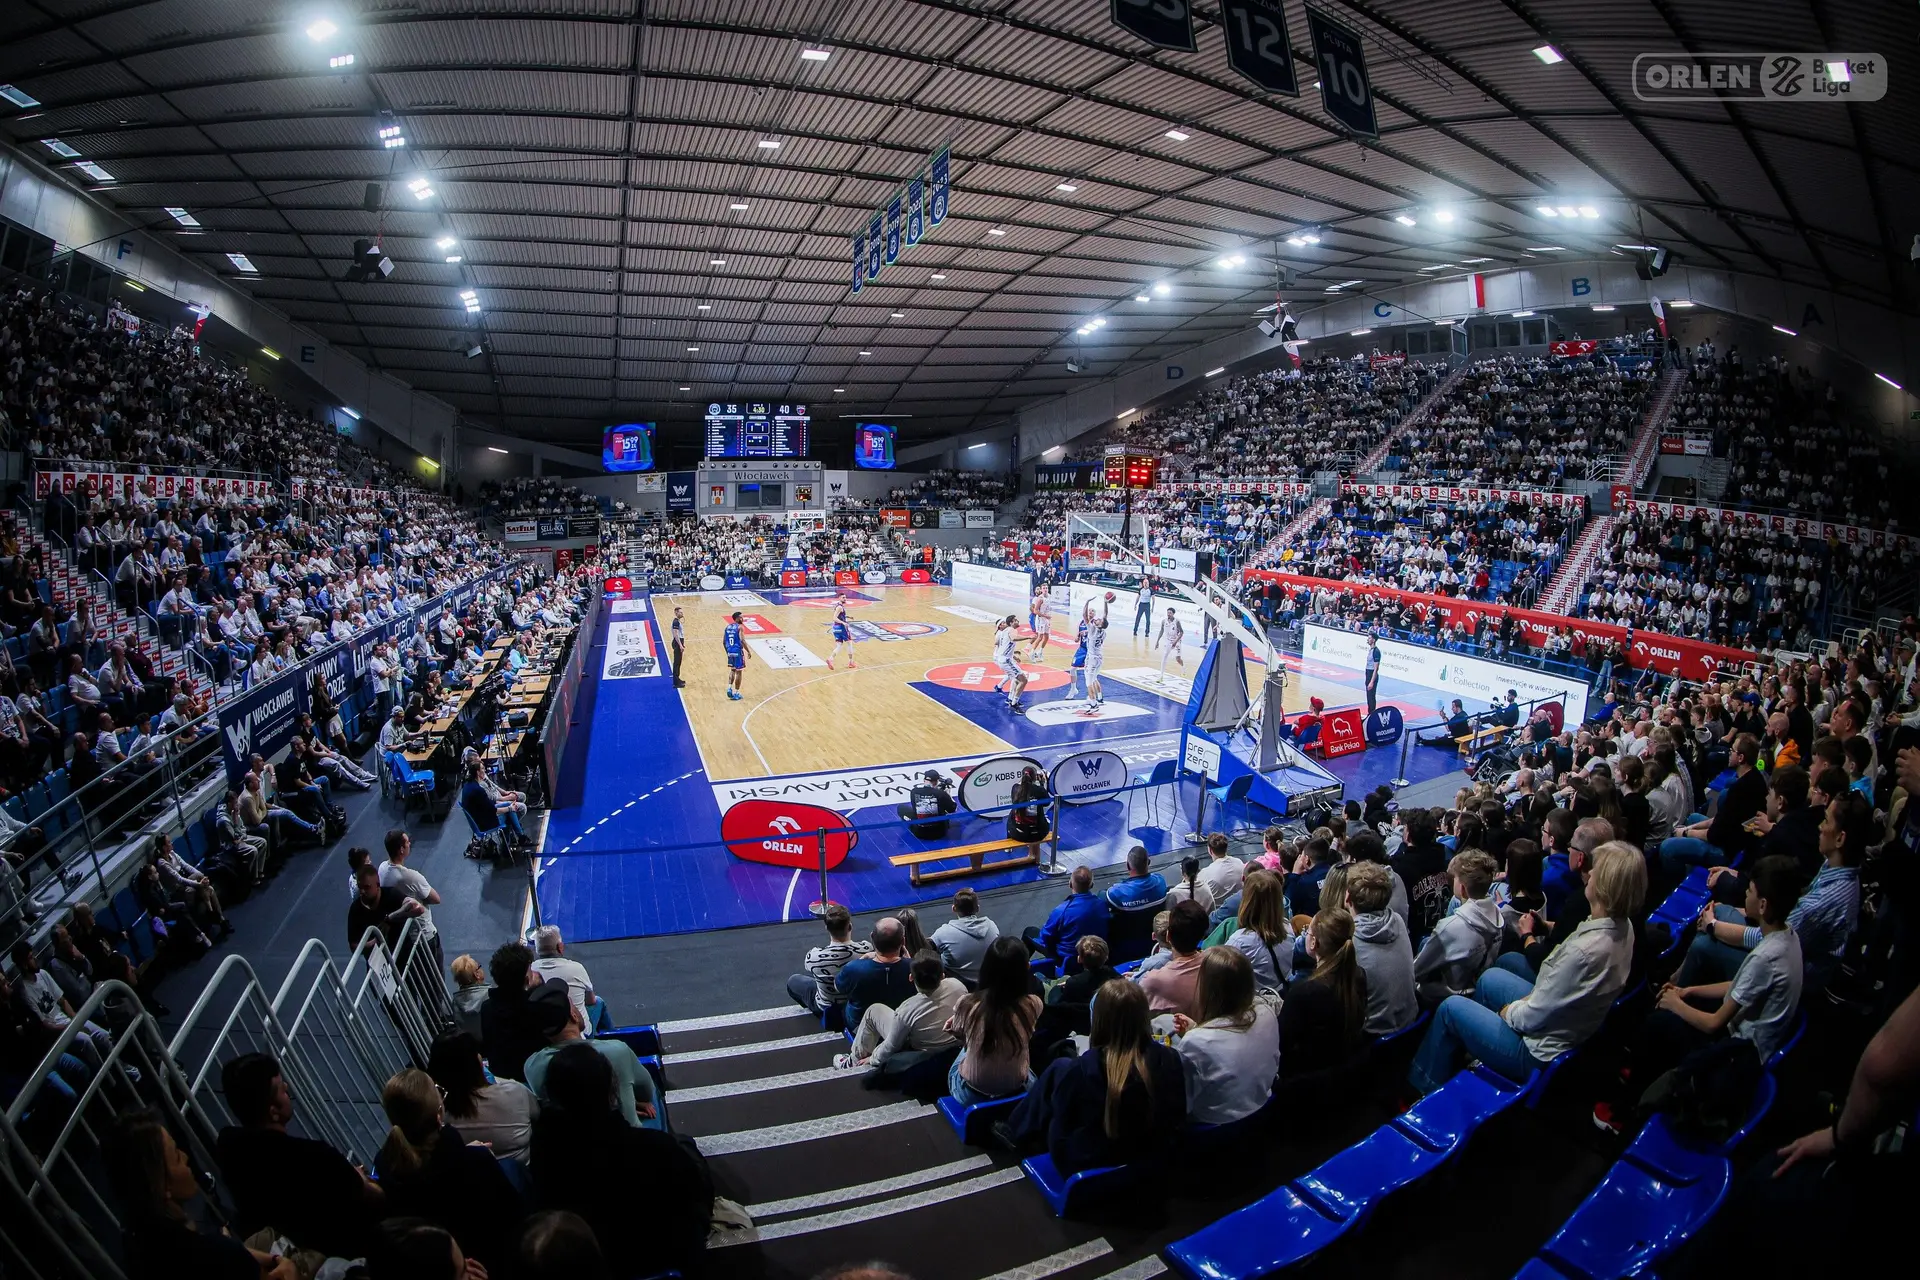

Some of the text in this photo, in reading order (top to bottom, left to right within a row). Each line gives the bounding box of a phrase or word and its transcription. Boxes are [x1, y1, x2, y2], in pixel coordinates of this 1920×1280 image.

[1232, 8, 1284, 66] 12
[1323, 31, 1352, 54] PLUTA
[1322, 53, 1365, 106] 10
[932, 174, 948, 196] 2023
[909, 197, 923, 216] 2022
[118, 240, 133, 260] F
[1572, 278, 1591, 296] B
[1374, 302, 1392, 318] C
[300, 346, 316, 363] E
[1166, 366, 1184, 380] D
[726, 405, 737, 414] 35
[779, 405, 790, 414] 40
[734, 471, 790, 480] Włocławek
[1322, 646, 1352, 659] Collection
[1650, 648, 1681, 660] ORLEN
[1454, 667, 1464, 675] RS
[1453, 677, 1490, 692] Collection
[1496, 675, 1527, 689] Inwestycje
[252, 687, 294, 725] WŁOCŁAWEK
[1187, 741, 1204, 754] pre
[1330, 741, 1360, 753] Bank Pekao
[1186, 752, 1209, 769] zero
[995, 773, 1015, 782] KDBS
[1073, 780, 1111, 792] WŁOCŁAWEK
[763, 840, 803, 855] ORLEN
